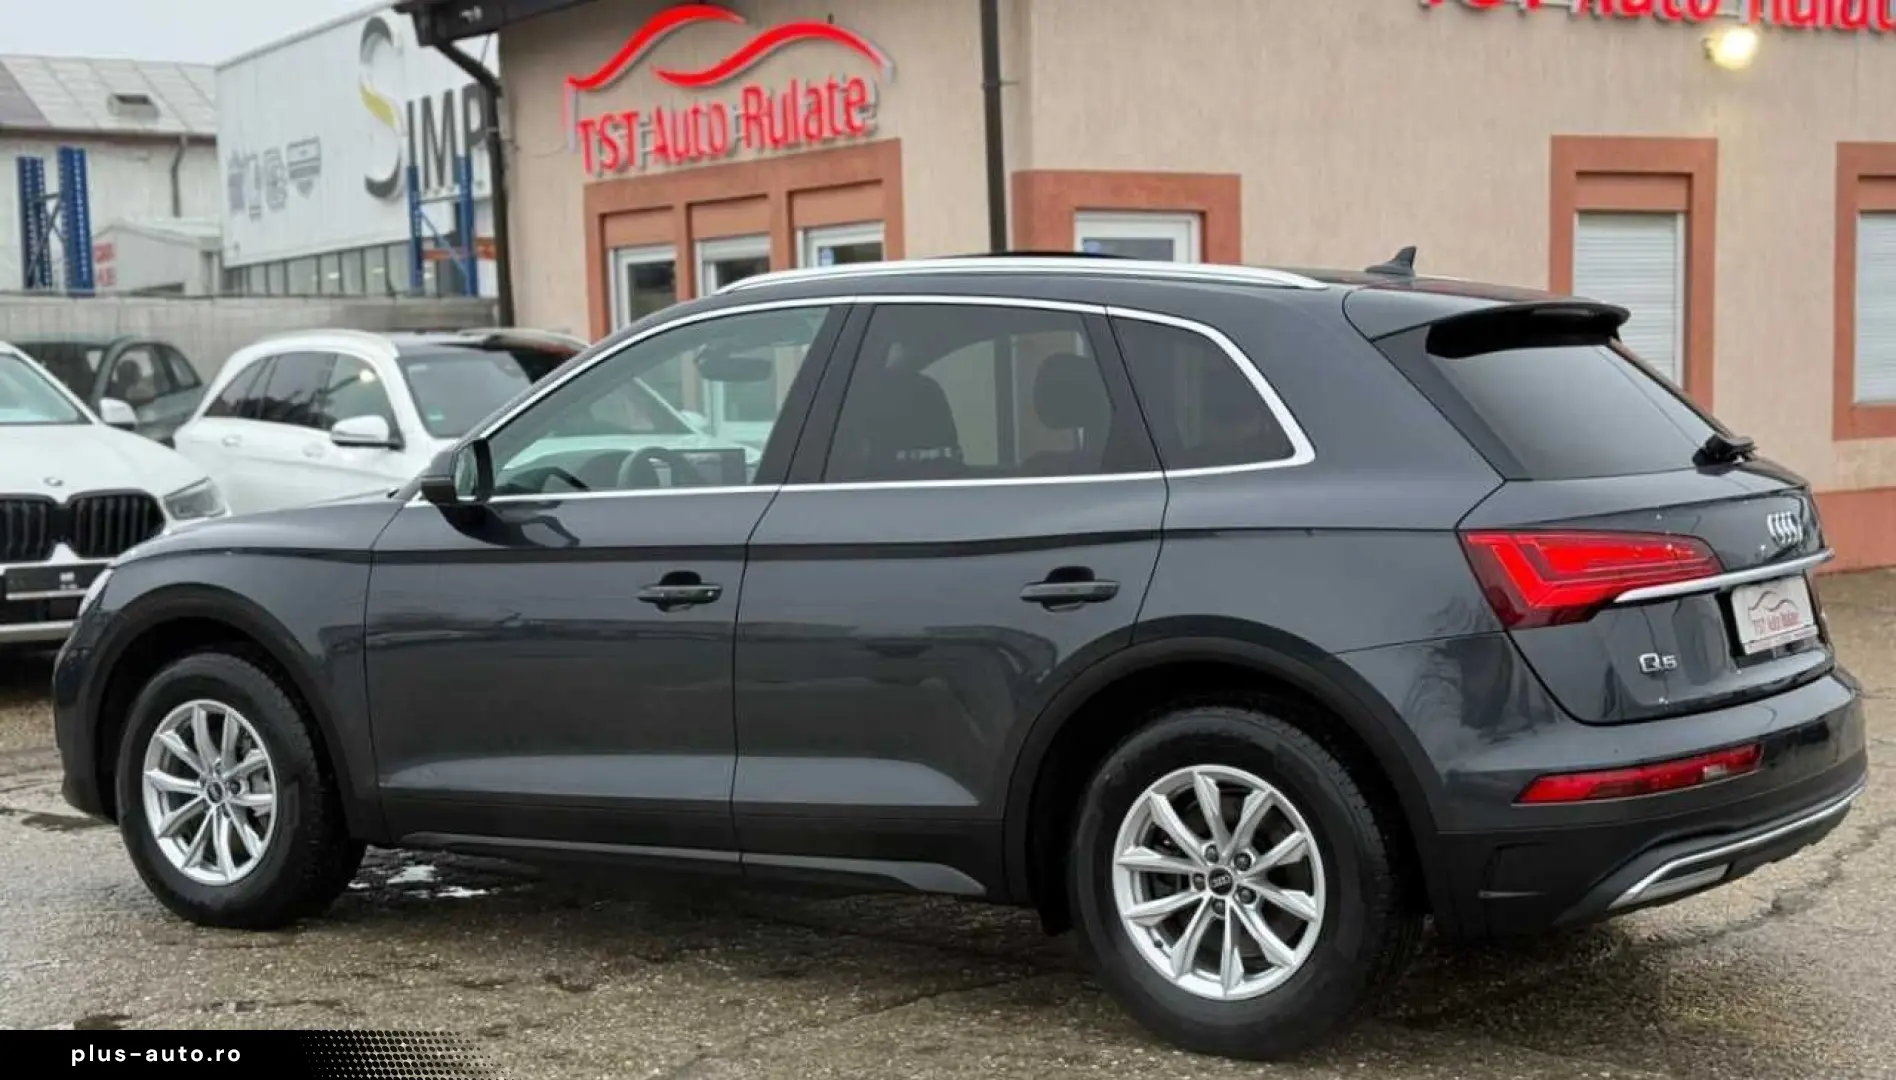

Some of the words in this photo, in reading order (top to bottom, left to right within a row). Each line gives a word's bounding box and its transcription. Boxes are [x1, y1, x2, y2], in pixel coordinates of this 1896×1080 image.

[577, 111, 641, 175] TST
[652, 102, 730, 164] Auto
[740, 76, 868, 149] Rulate
[1639, 652, 1678, 672] Q5
